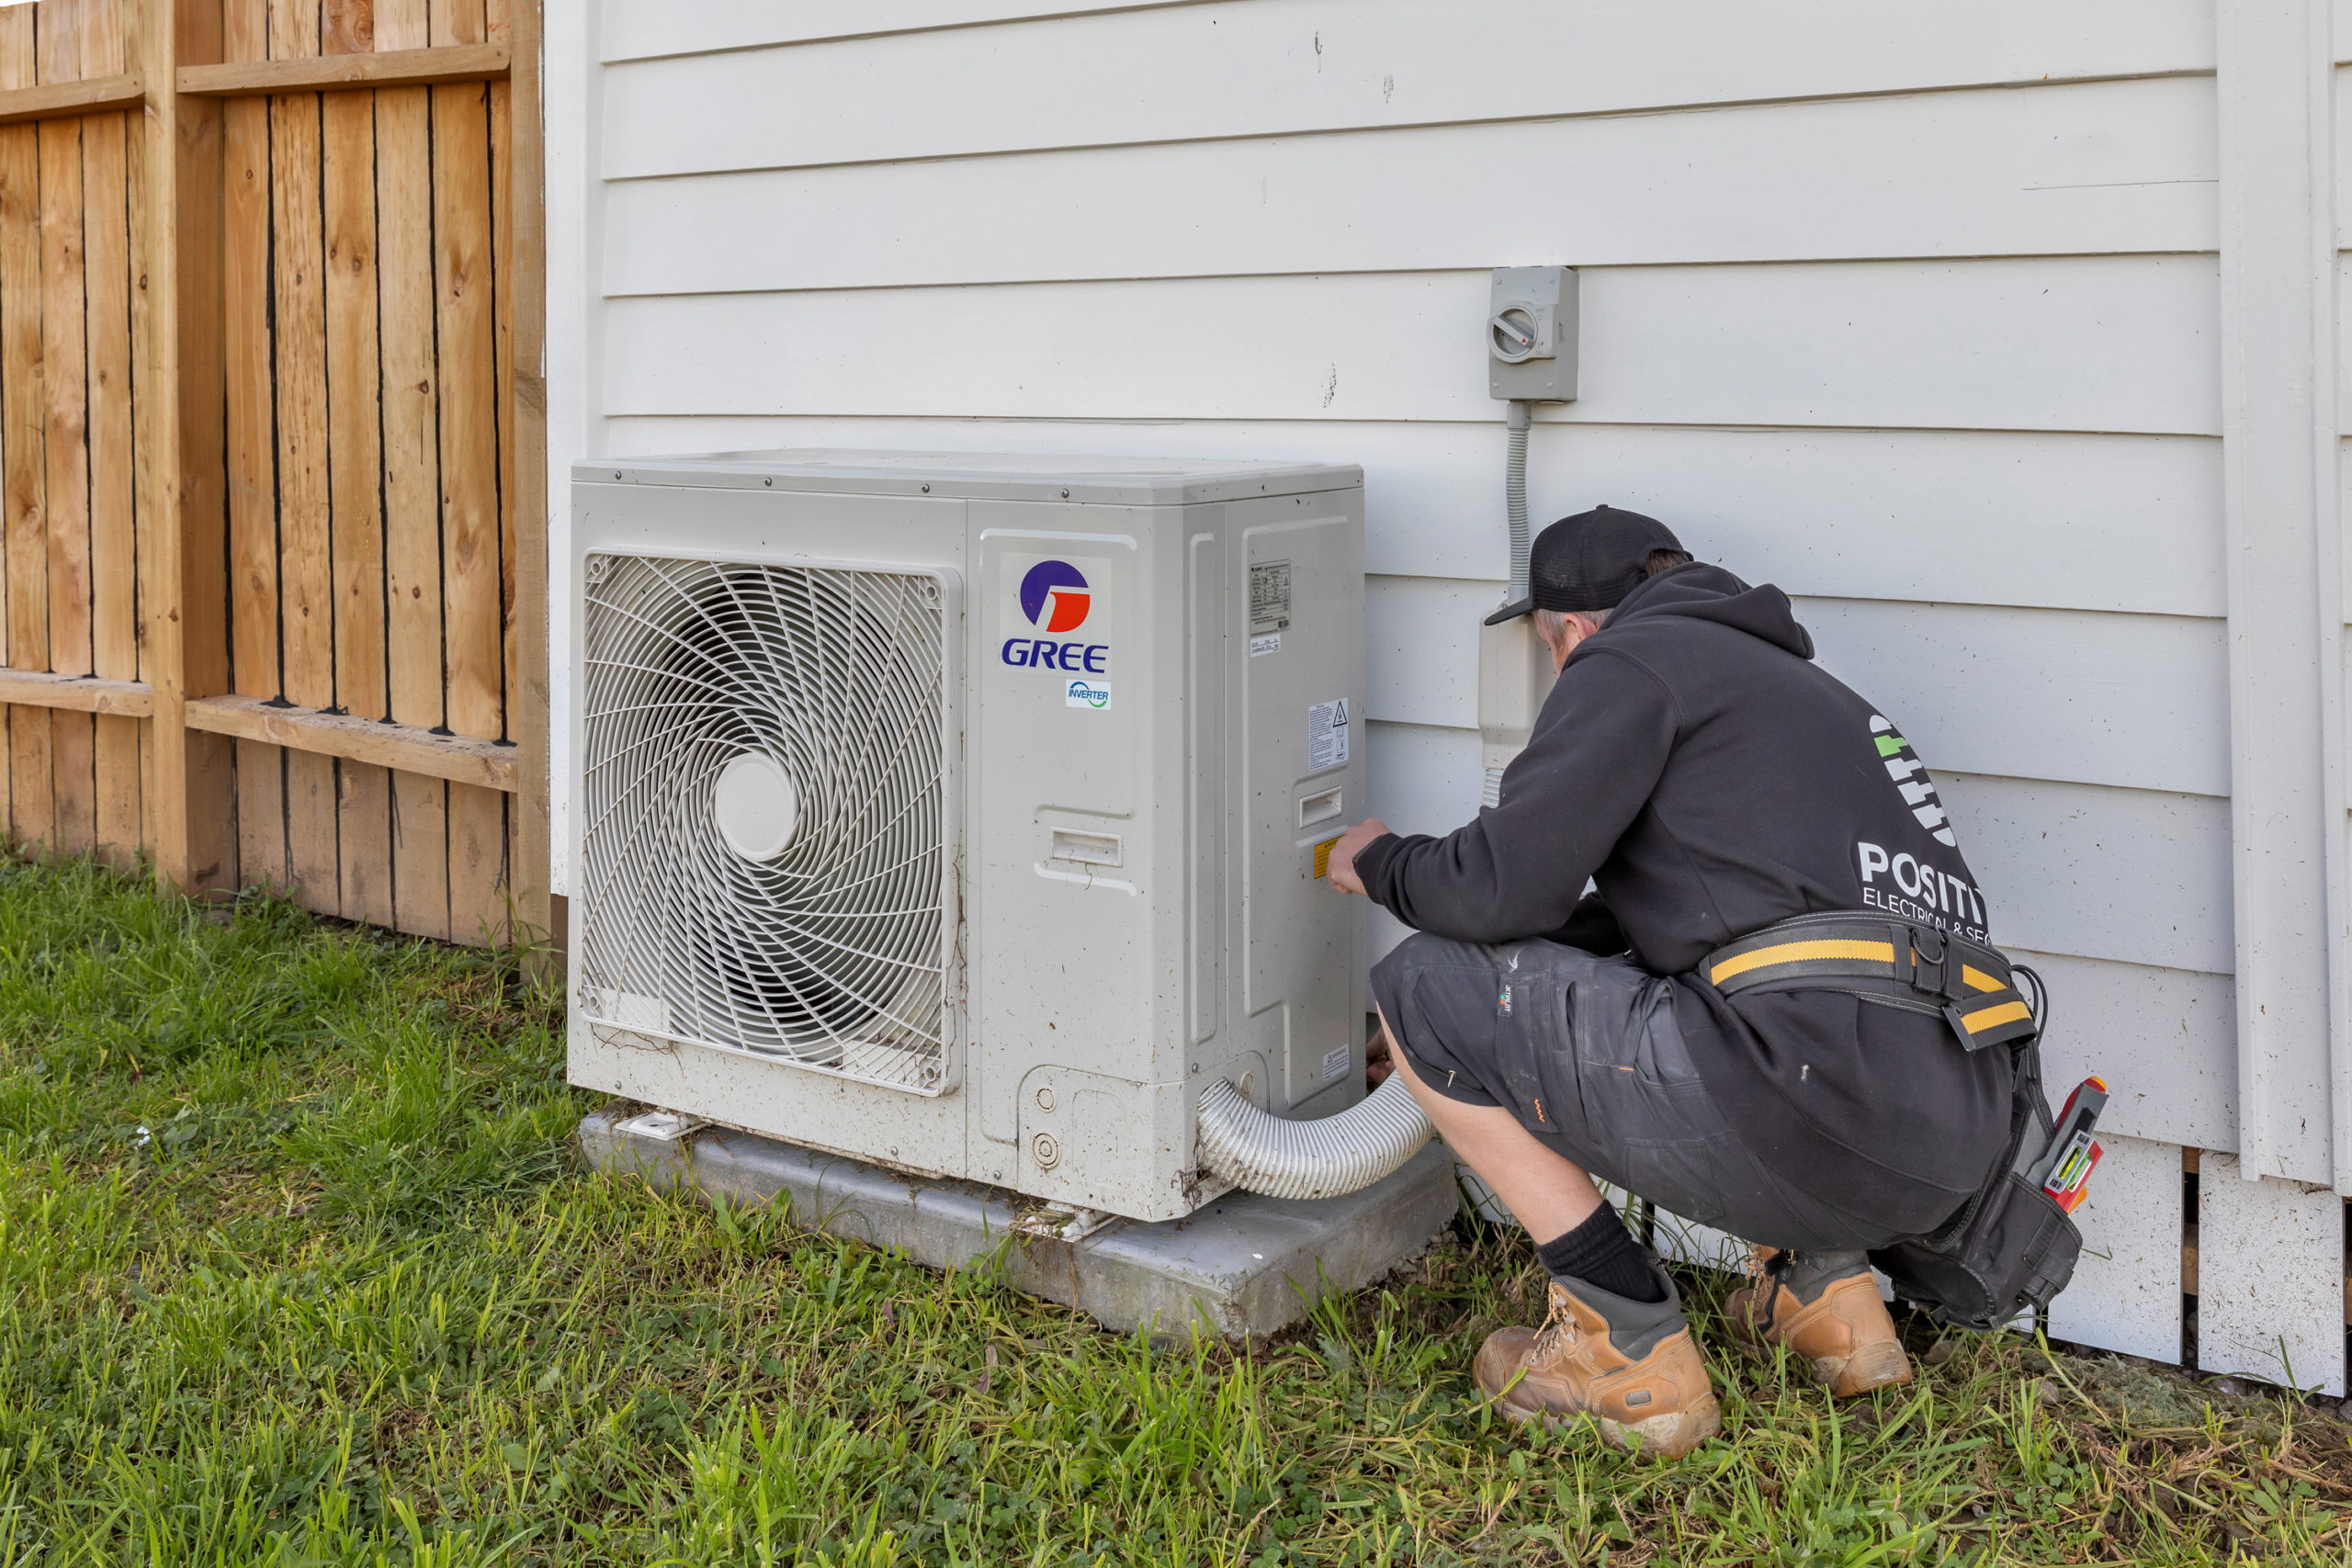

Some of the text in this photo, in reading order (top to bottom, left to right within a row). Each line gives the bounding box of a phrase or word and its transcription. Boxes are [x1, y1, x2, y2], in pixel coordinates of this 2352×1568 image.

[1001, 637, 1109, 673] GREE
[1069, 689, 1109, 701] INVERTER
[1857, 841, 1984, 925] POSITI
